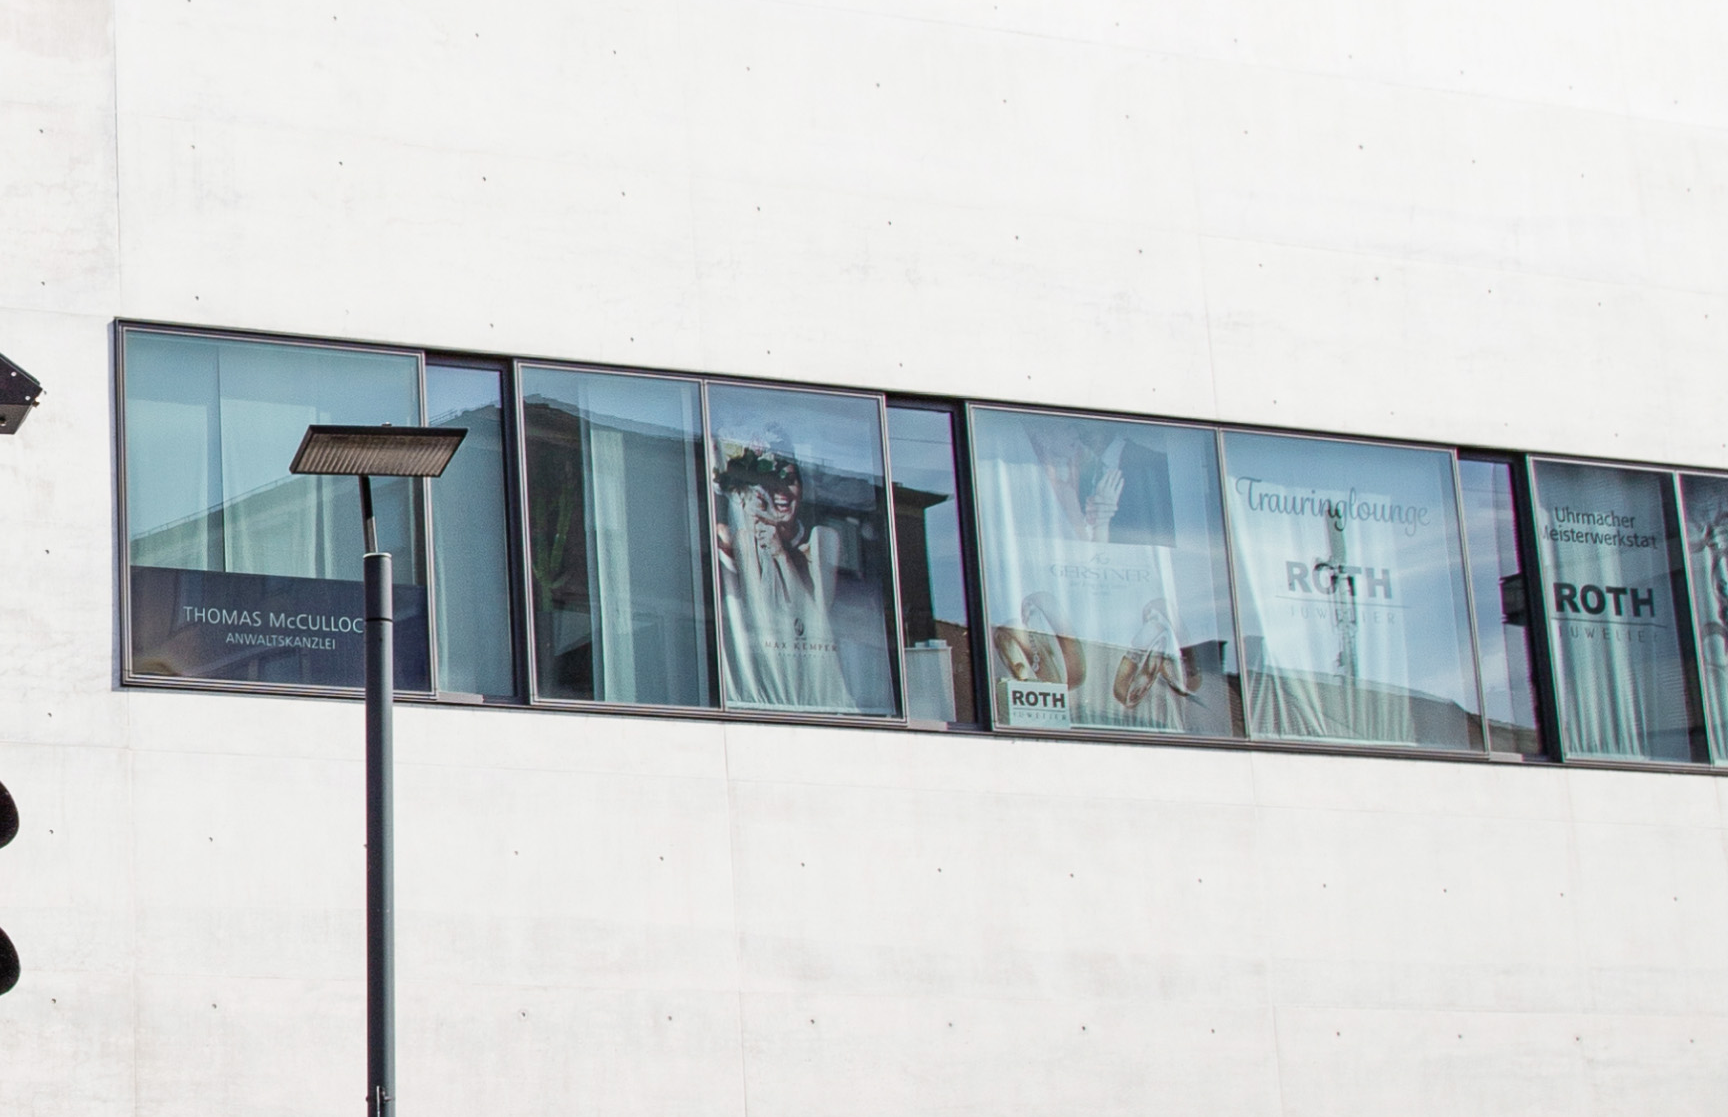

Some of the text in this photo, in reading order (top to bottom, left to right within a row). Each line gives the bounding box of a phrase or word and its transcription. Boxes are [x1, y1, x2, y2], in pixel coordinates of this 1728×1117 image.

[1234, 476, 1431, 538] Trauringlounge
[1554, 506, 1636, 529] Uhrmacher
[1285, 560, 1393, 600] ROTH
[1552, 581, 1656, 618] ROTH
[183, 605, 365, 634] THOMAS McCULLOC
[225, 632, 336, 650] ANWALTSKANZLEI
[1011, 689, 1066, 709] ROTH
